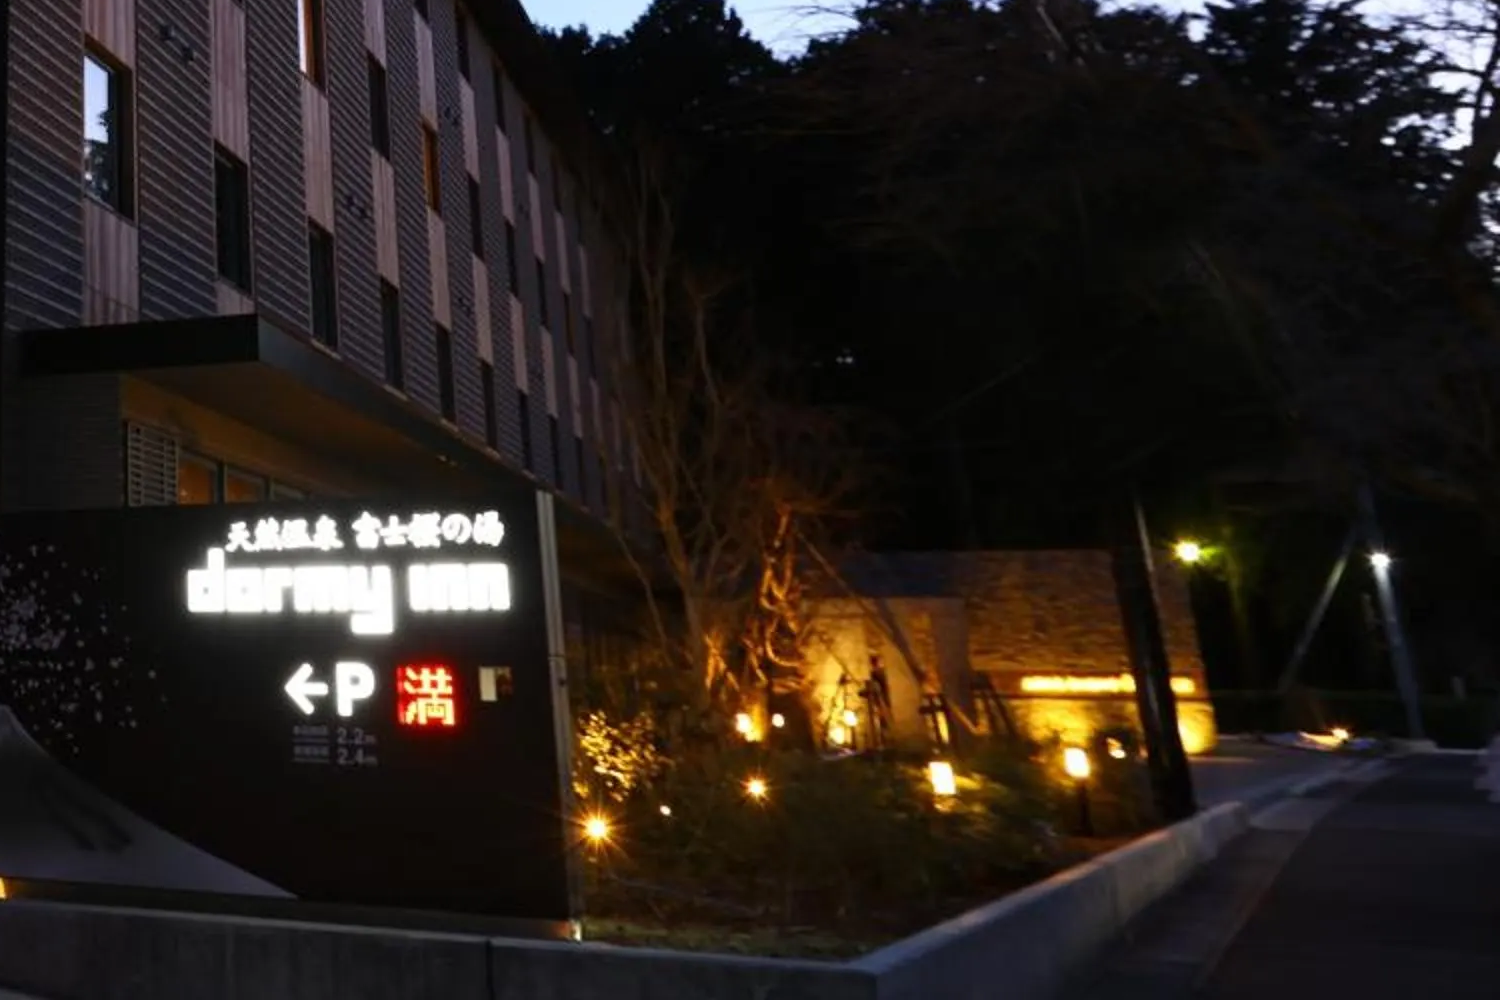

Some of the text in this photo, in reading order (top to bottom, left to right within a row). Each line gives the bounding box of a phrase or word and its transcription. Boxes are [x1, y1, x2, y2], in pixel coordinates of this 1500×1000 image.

[225, 515, 344, 551] 天然温泉
[187, 547, 511, 635] dormy inn
[335, 661, 375, 717] P
[401, 665, 456, 726] 満
